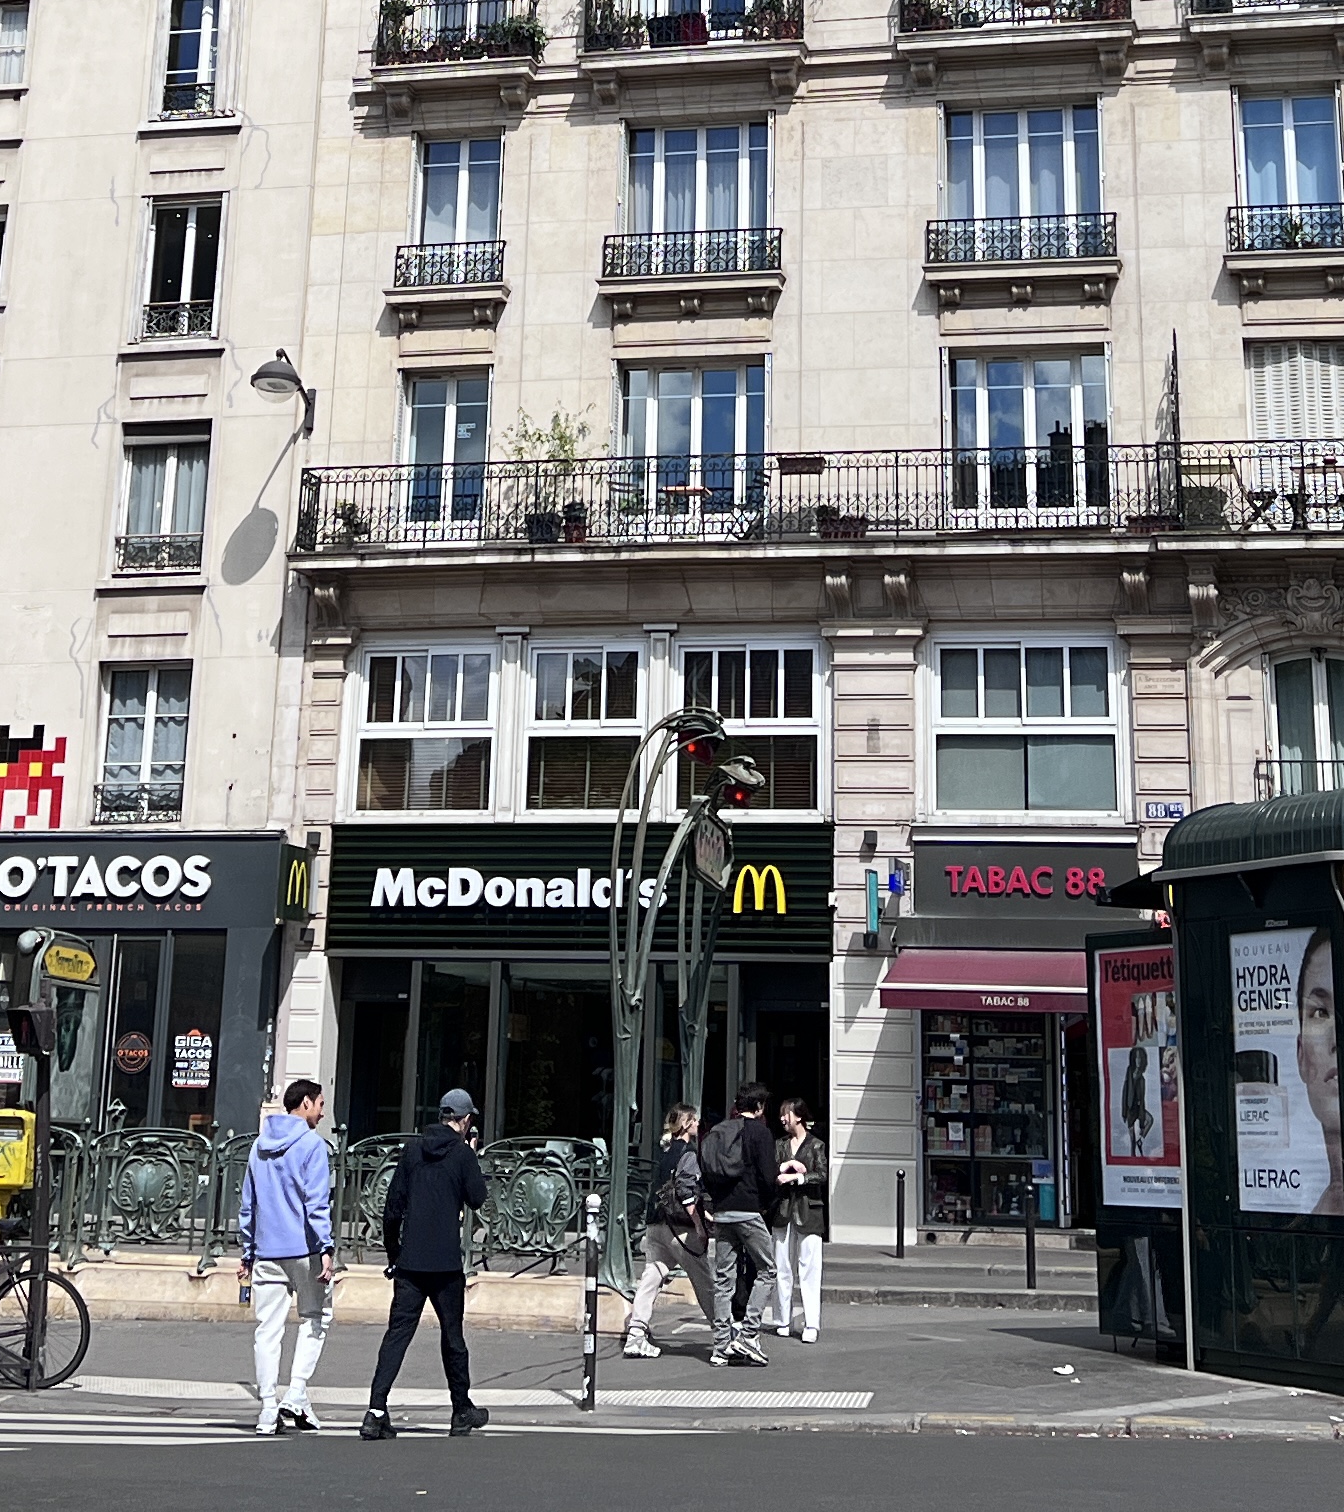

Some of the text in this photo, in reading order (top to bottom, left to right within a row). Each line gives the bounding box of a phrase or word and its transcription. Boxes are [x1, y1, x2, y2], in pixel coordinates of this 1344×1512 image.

[1148, 803, 1166, 818] 88
[370, 867, 668, 908] McDonald's
[944, 865, 1106, 896] TABAC 88
[3, 903, 203, 912] ORIGINAL FRENCH TACOS
[1234, 943, 1291, 957] NOUVEAU
[1104, 955, 1174, 986] l'étiquett
[1236, 963, 1291, 989] HYDRA
[980, 995, 1030, 1007] TABAC 88
[1237, 988, 1292, 1013] GENIST
[175, 1036, 213, 1048] GIGA
[174, 1048, 213, 1059] TACOS
[1240, 1110, 1270, 1122] LIERAC
[1244, 1168, 1301, 1189] LIERAC
